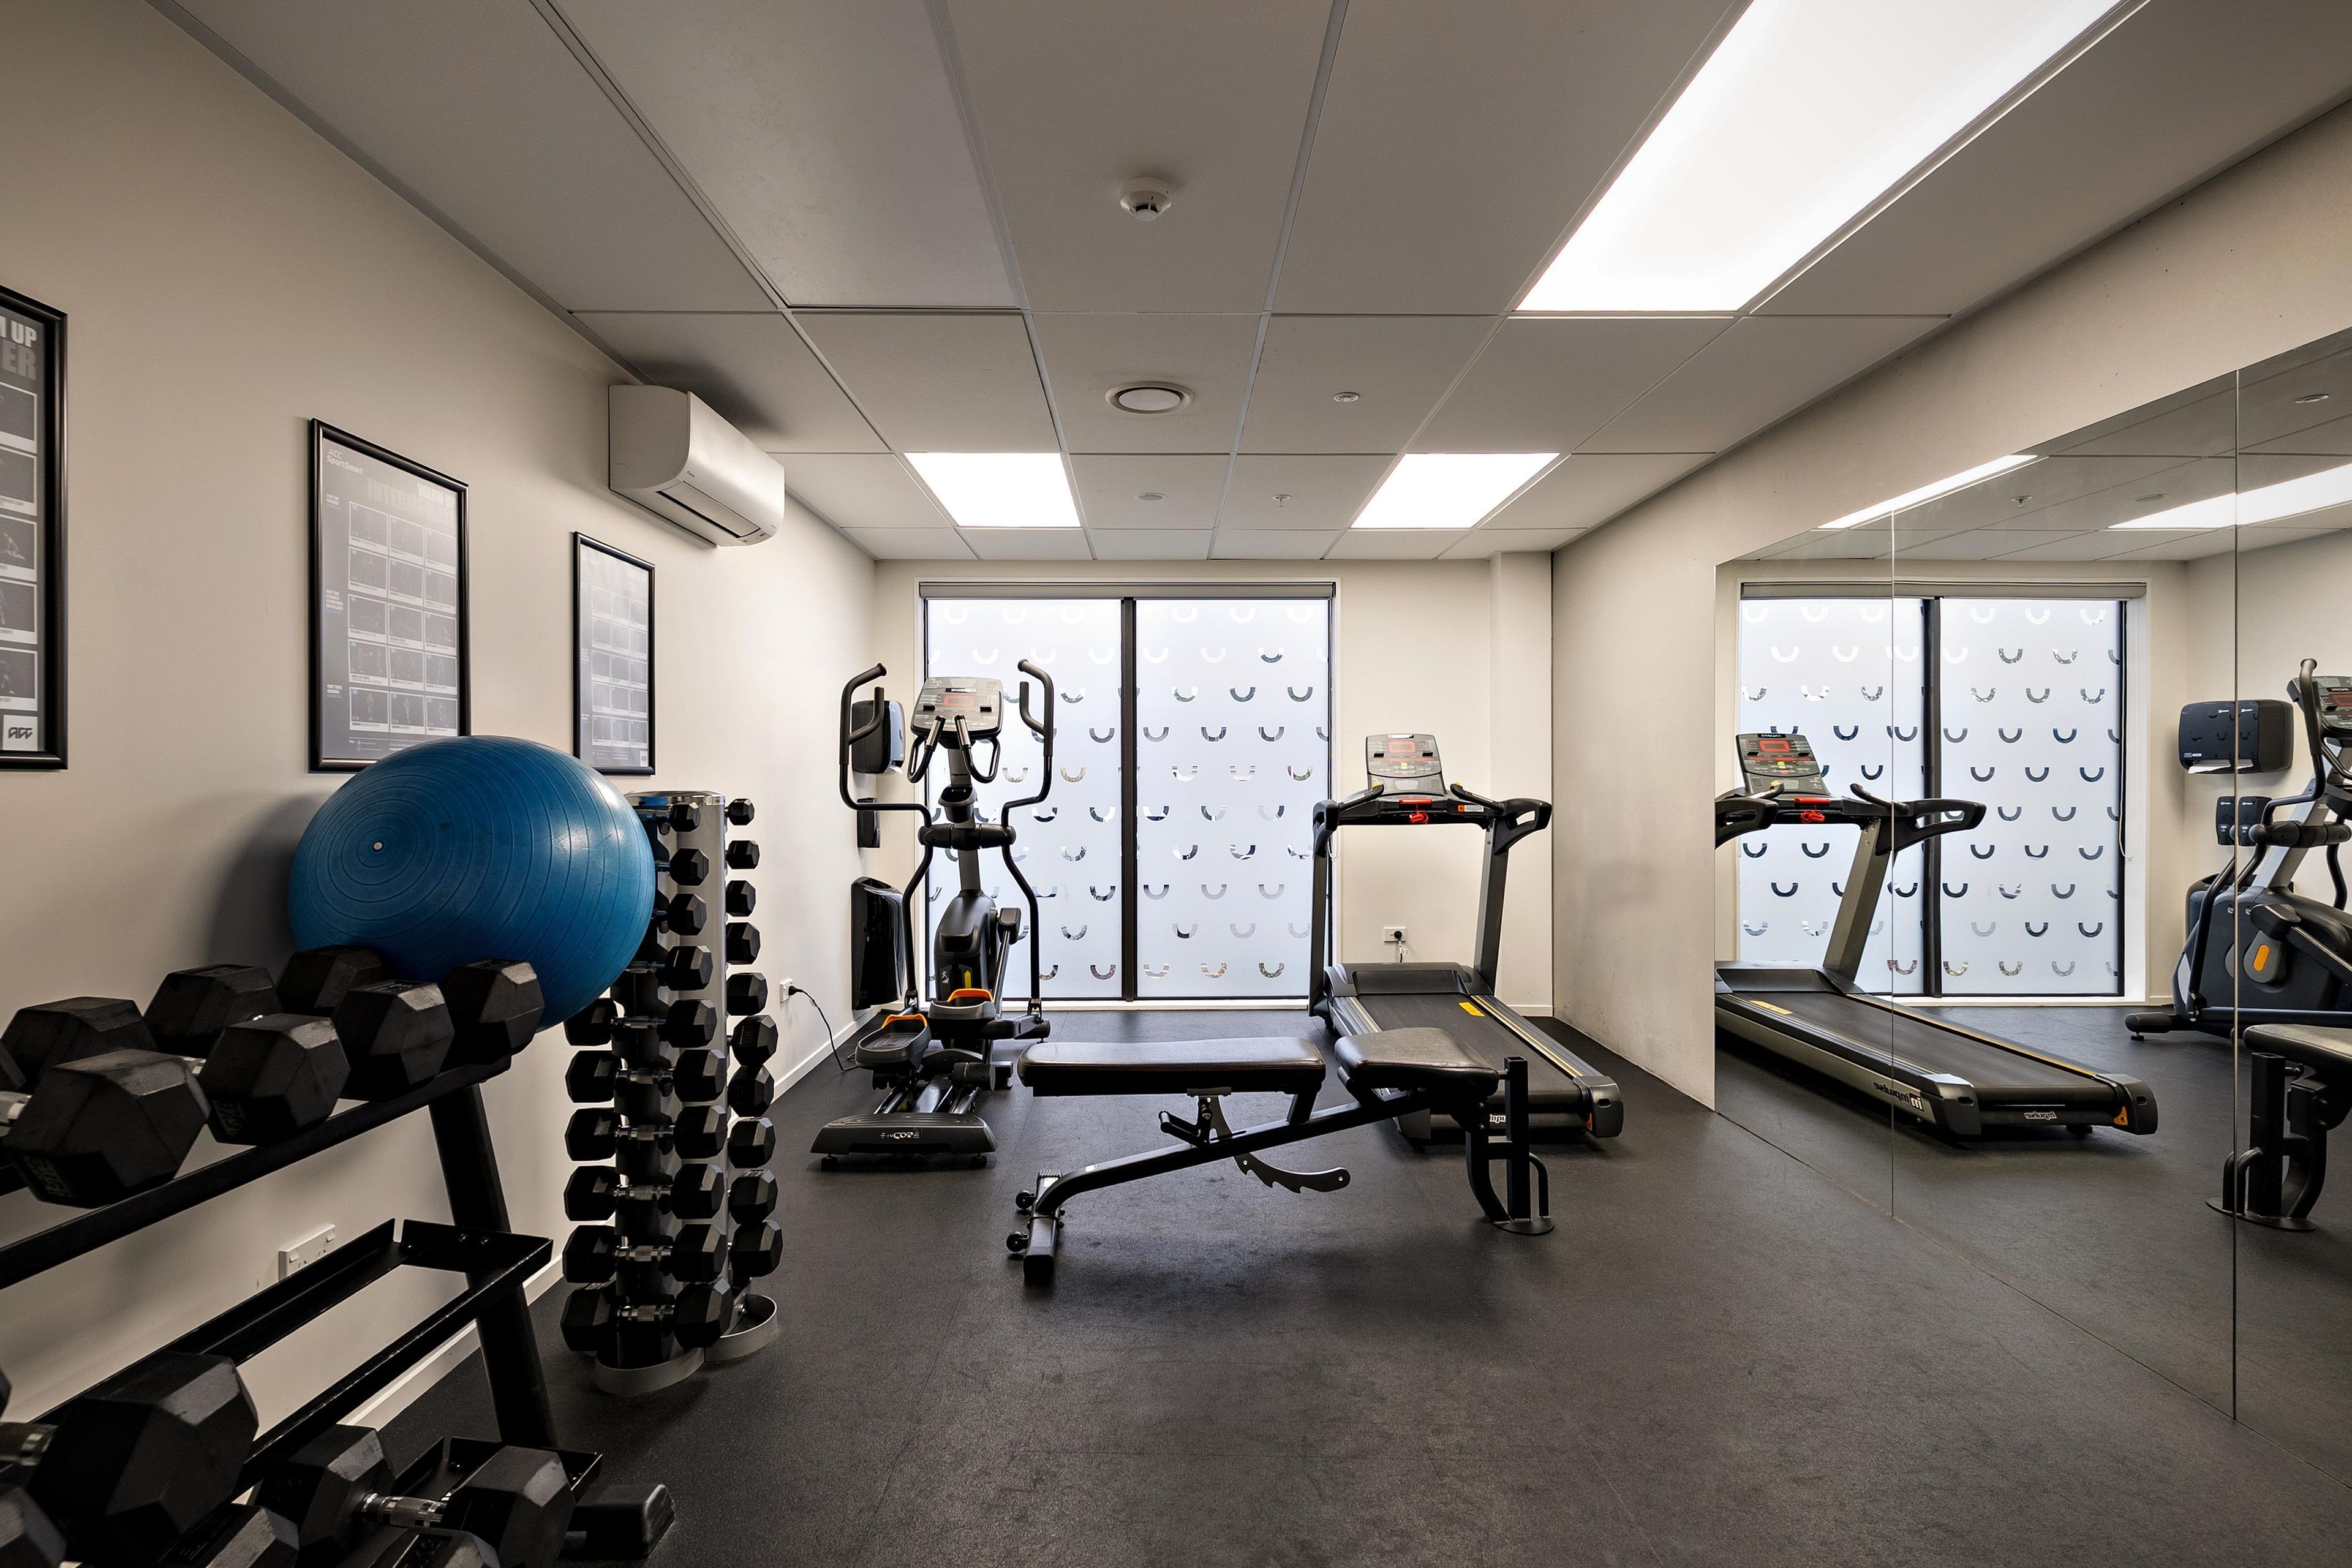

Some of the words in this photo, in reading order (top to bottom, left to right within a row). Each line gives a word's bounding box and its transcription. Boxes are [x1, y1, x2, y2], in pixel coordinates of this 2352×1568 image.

[11, 320, 37, 347] UP
[2, 339, 36, 380] ER
[326, 454, 363, 475] SportSmart
[328, 448, 343, 459] ACC
